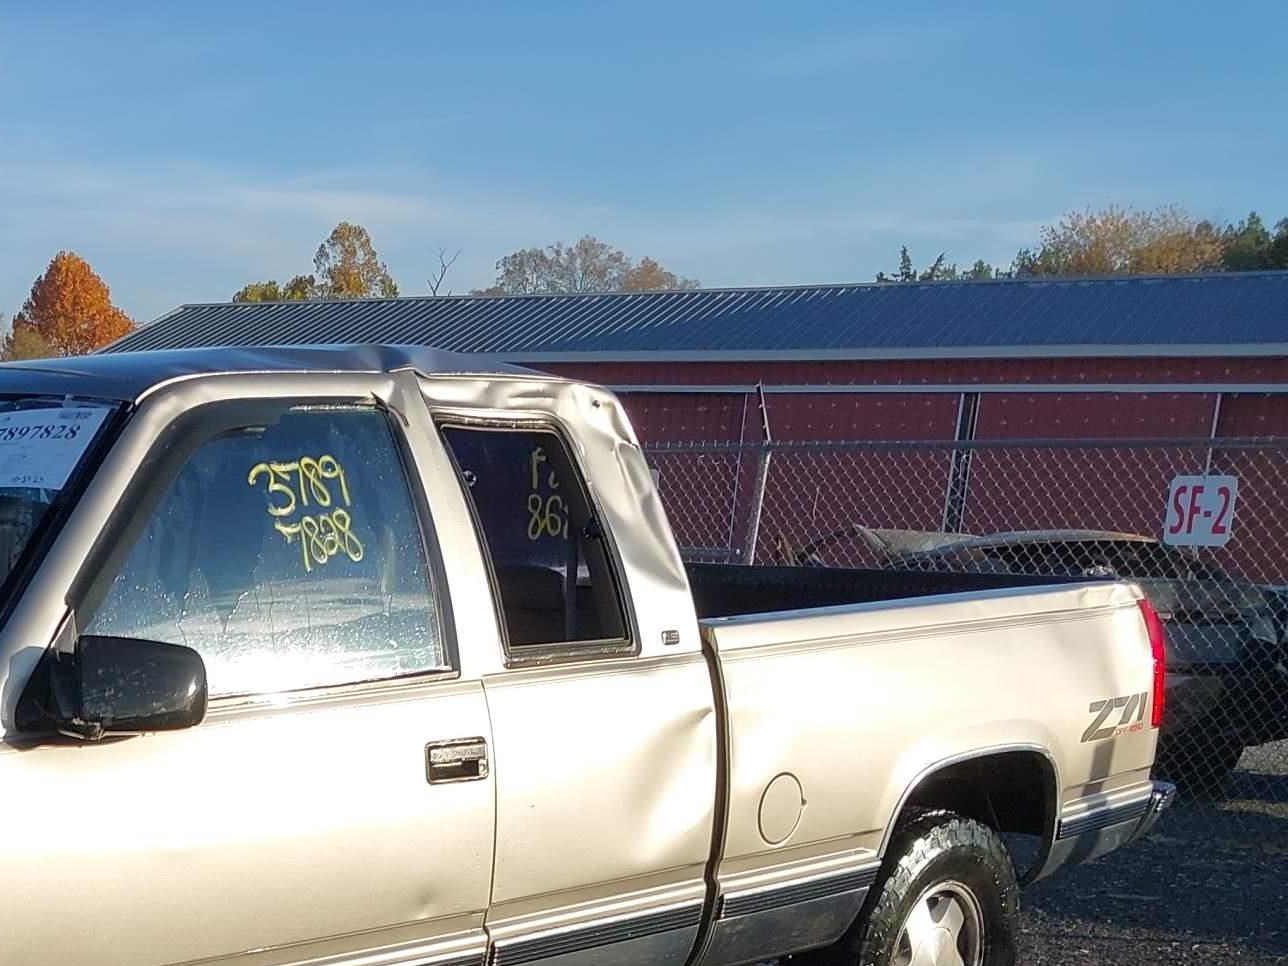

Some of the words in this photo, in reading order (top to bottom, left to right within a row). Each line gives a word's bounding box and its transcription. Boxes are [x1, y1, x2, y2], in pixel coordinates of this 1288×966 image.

[248, 454, 351, 516] 3789
[1169, 485, 1230, 535] SF-2
[274, 508, 364, 572] 7828
[1080, 691, 1148, 743] Z71
